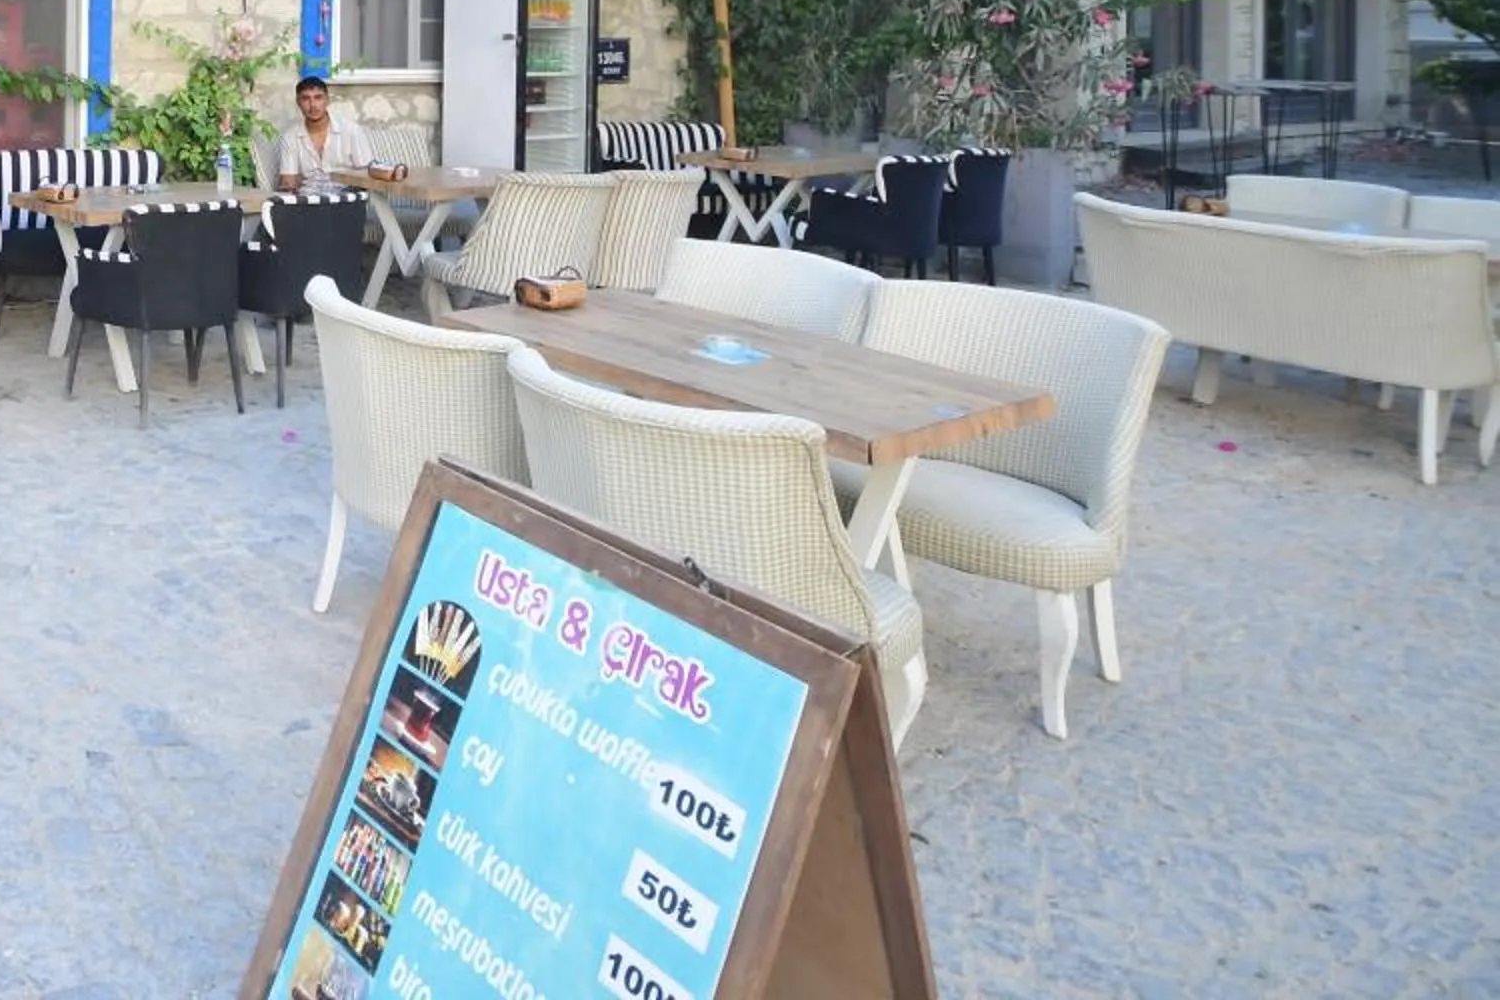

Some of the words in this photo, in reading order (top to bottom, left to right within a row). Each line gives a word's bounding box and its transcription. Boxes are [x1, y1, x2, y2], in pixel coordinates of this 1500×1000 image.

[475, 550, 550, 629] Usta
[560, 600, 590, 651] &
[462, 736, 507, 788] çay
[488, 663, 578, 738] çubukta
[578, 718, 656, 790] waffle
[660, 779, 736, 843] 100₺
[437, 811, 484, 869] türk
[478, 845, 575, 939] kahvesi
[637, 869, 698, 930] 50₺
[411, 889, 548, 1000] meşrubatla
[608, 952, 677, 1000] 100
